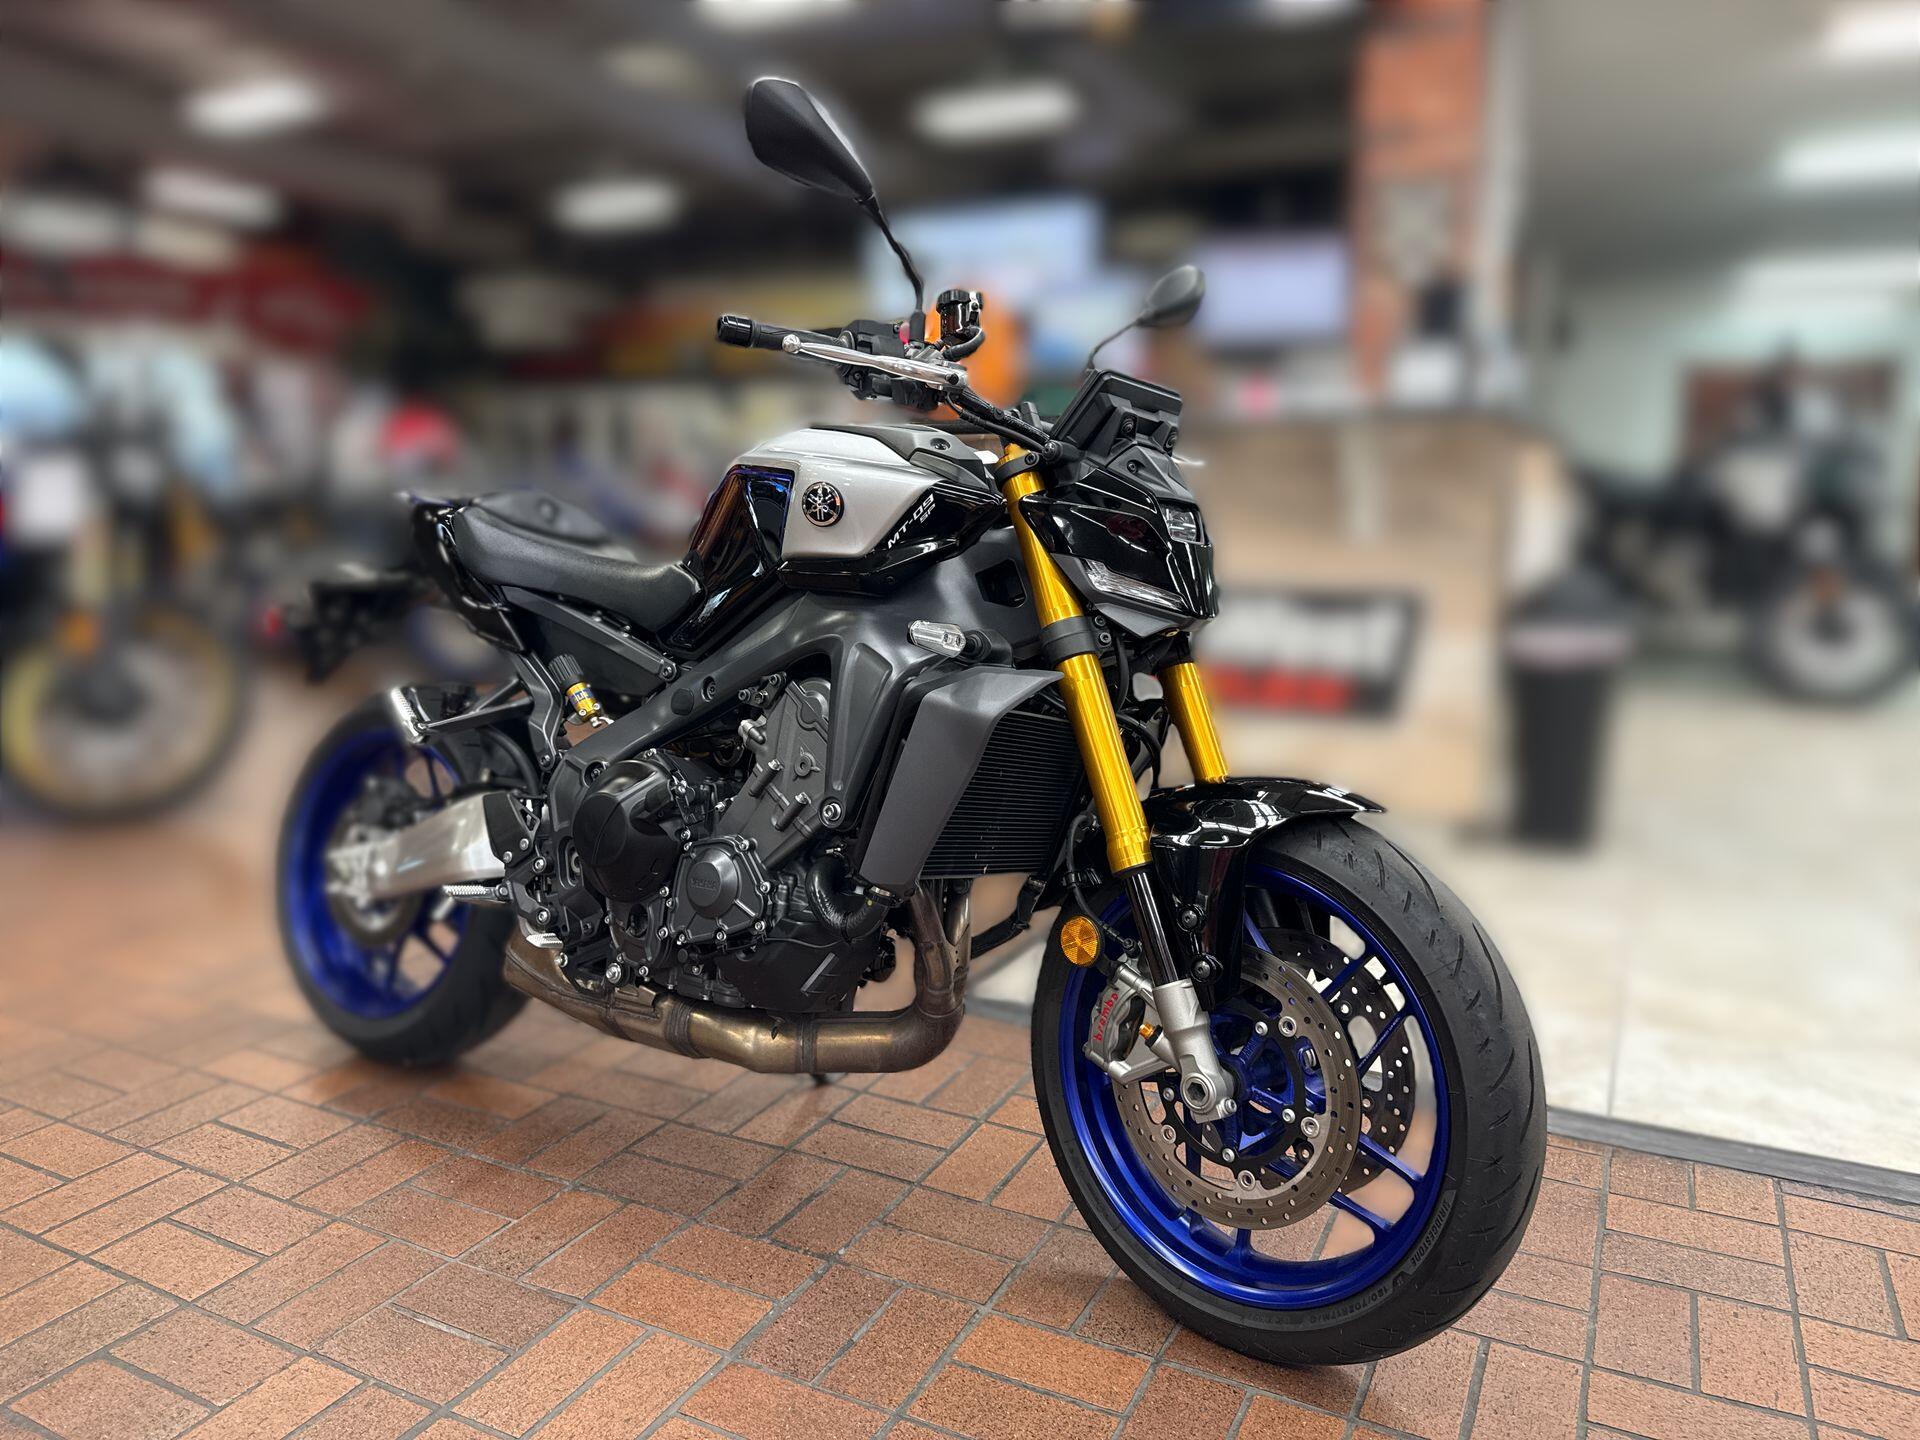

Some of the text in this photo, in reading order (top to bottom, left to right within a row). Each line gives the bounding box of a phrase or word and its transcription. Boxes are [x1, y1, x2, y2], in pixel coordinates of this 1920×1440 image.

[888, 493, 934, 549] MT-09
[920, 503, 935, 523] SP
[1093, 993, 1118, 1041] brembo
[1410, 1200, 1452, 1267] BRIDGESTONE
